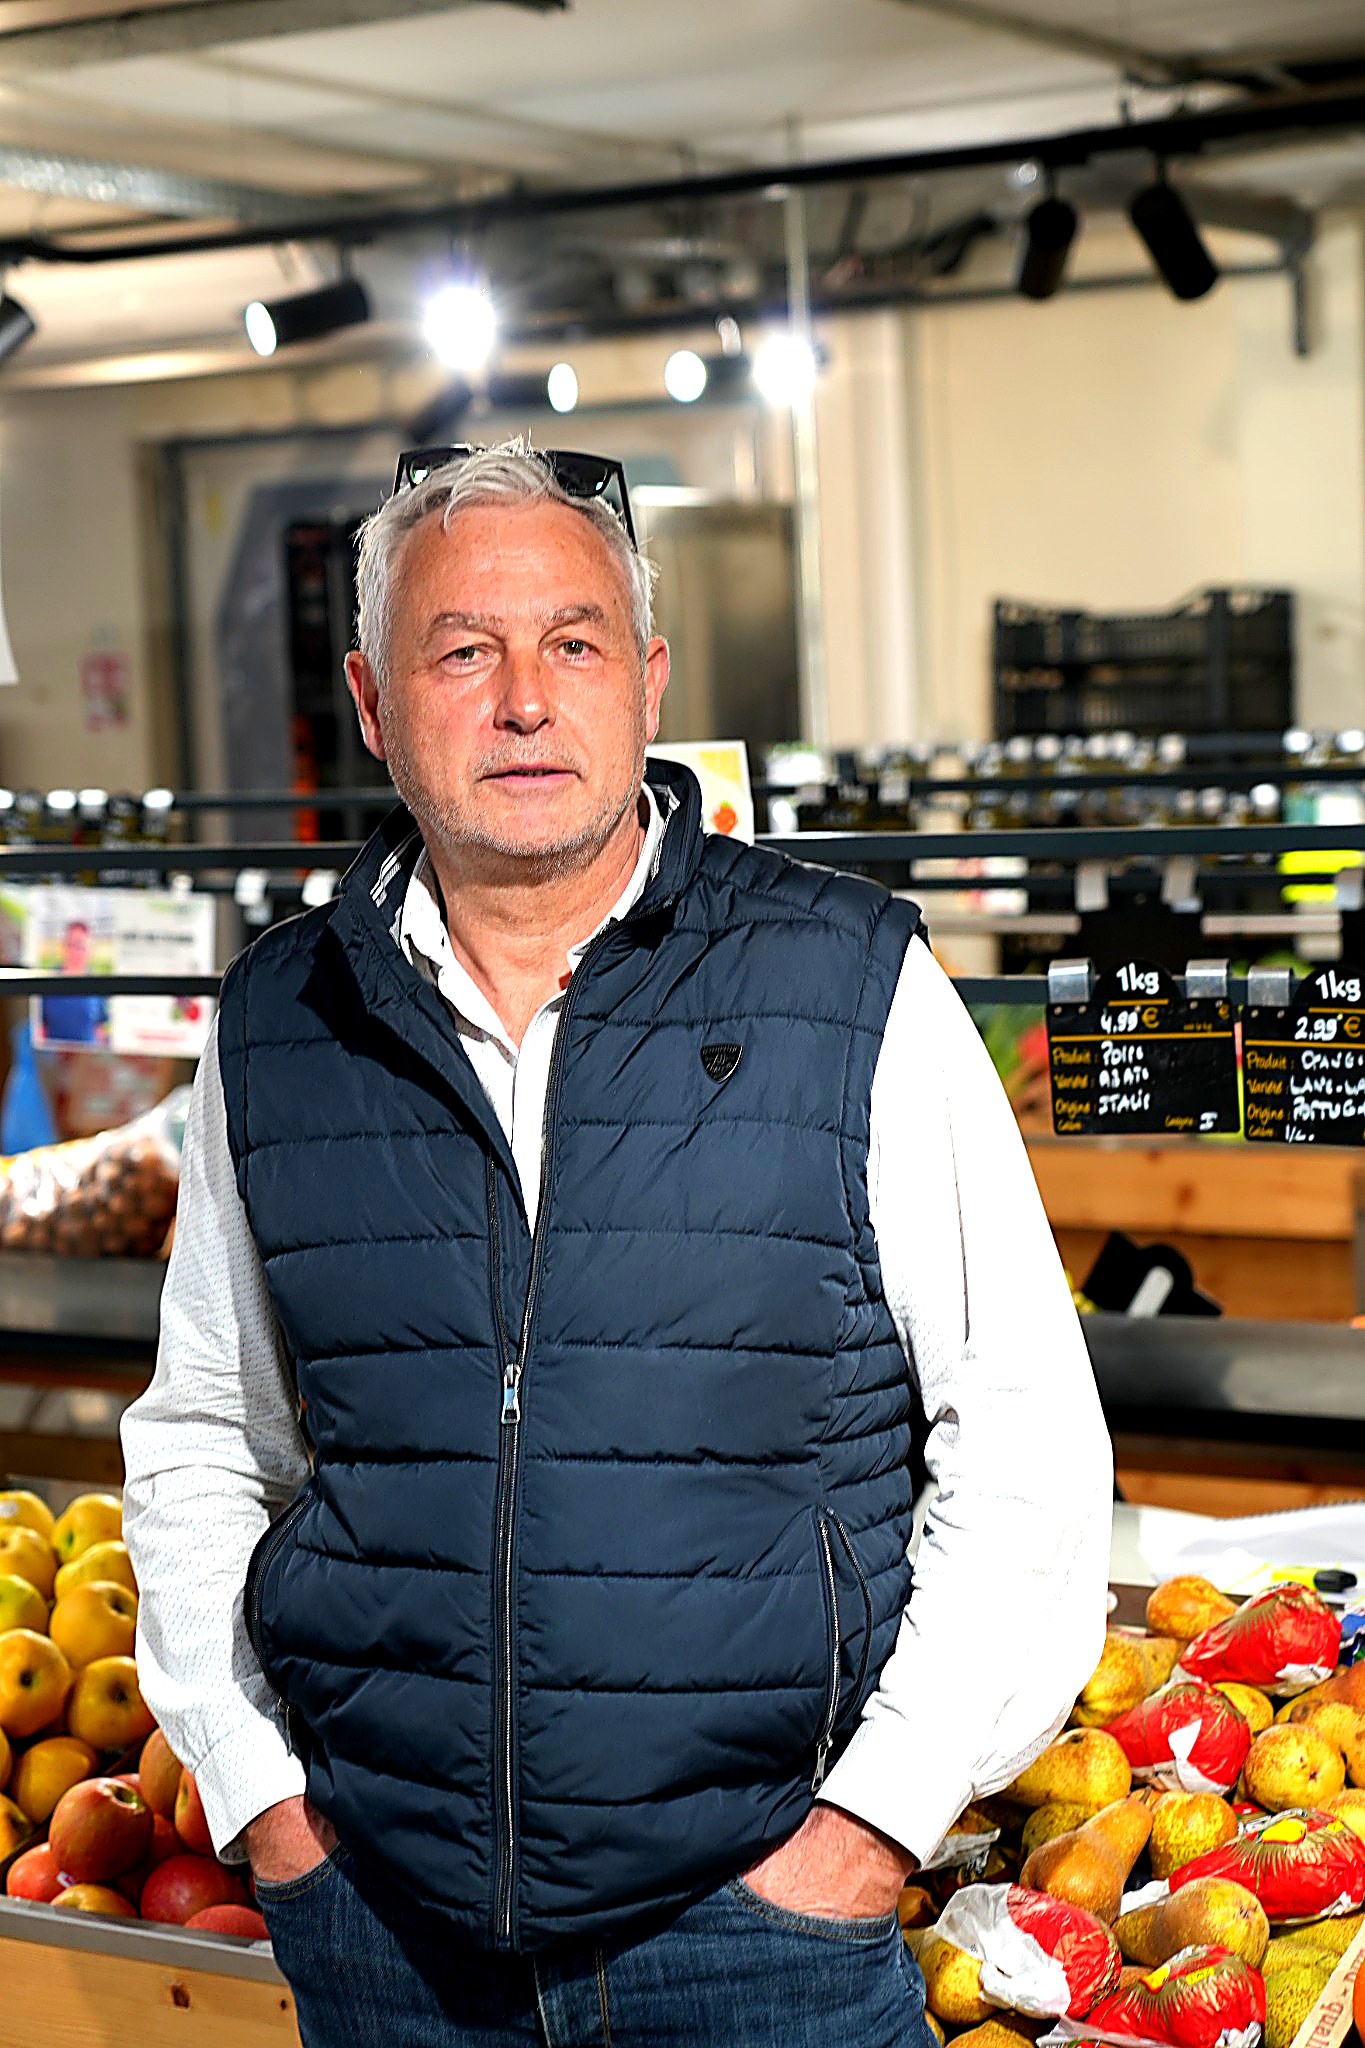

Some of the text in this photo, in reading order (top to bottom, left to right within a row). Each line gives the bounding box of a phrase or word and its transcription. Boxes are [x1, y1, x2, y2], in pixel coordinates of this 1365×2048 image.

[1116, 962, 1160, 995] 1kg
[1315, 969, 1362, 1003] 1kg
[1142, 1006, 1160, 1029] €
[1343, 1015, 1361, 1038] €
